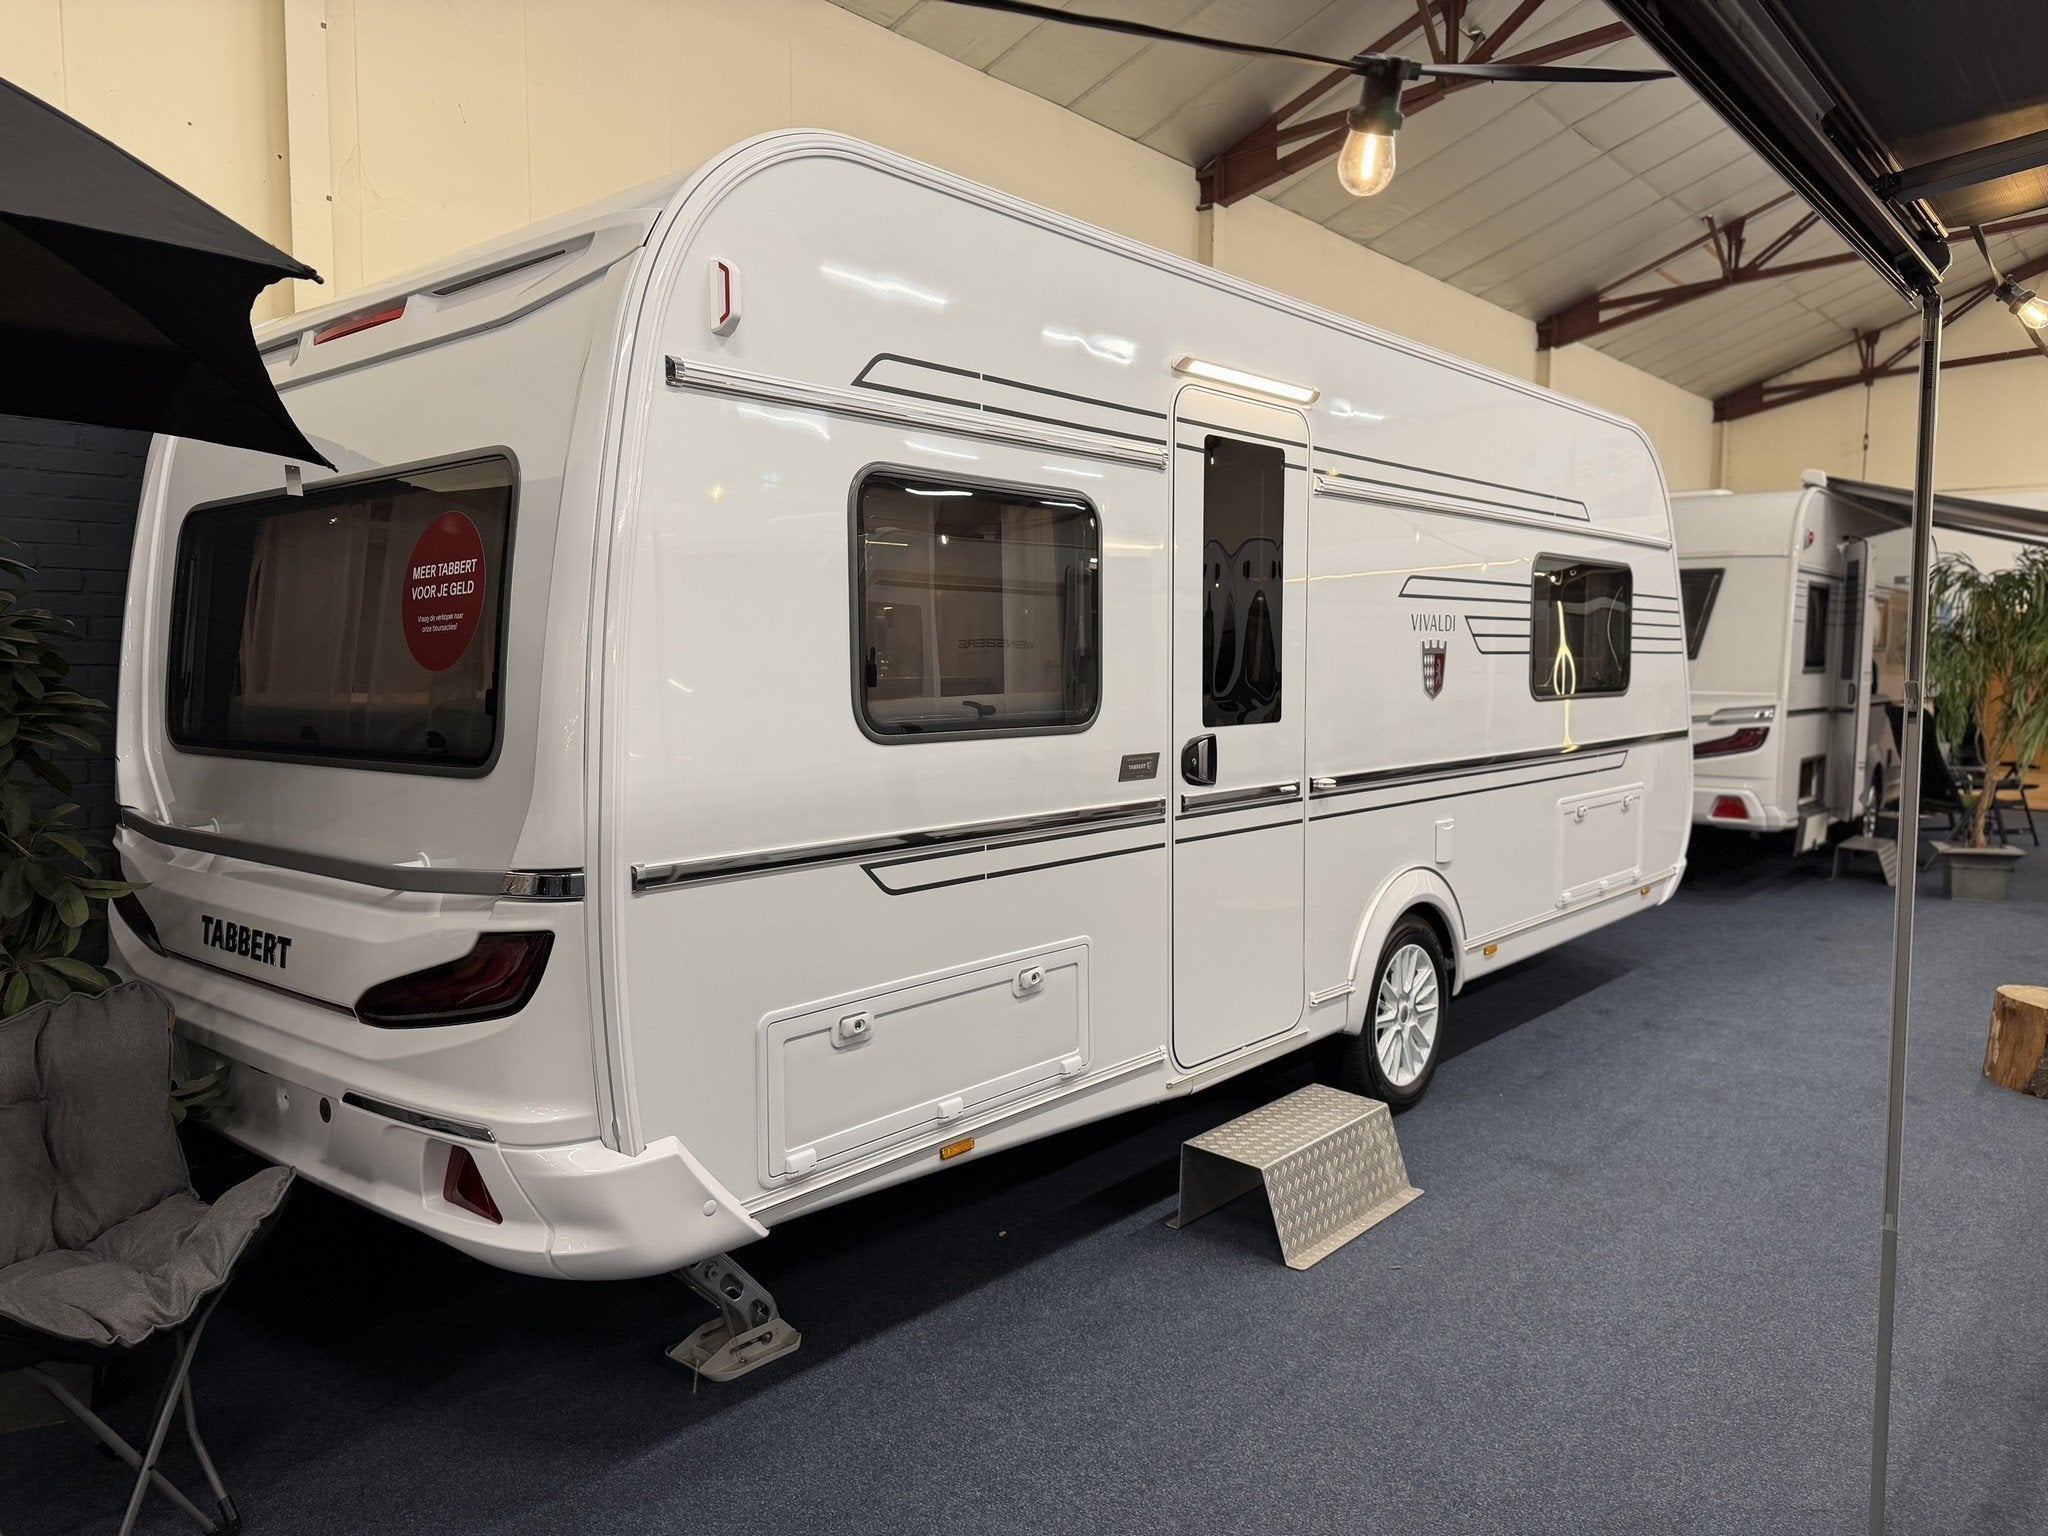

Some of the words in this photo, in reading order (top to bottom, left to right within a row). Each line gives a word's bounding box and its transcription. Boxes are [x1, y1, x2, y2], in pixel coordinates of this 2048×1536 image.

[412, 564, 437, 580] MEER
[438, 558, 478, 577] TABBERT
[411, 584, 437, 600] VOOR
[437, 582, 449, 598] JE
[449, 580, 475, 596] GELD
[1411, 613, 1456, 632] VIVALDI
[201, 914, 293, 969] TABBERT
